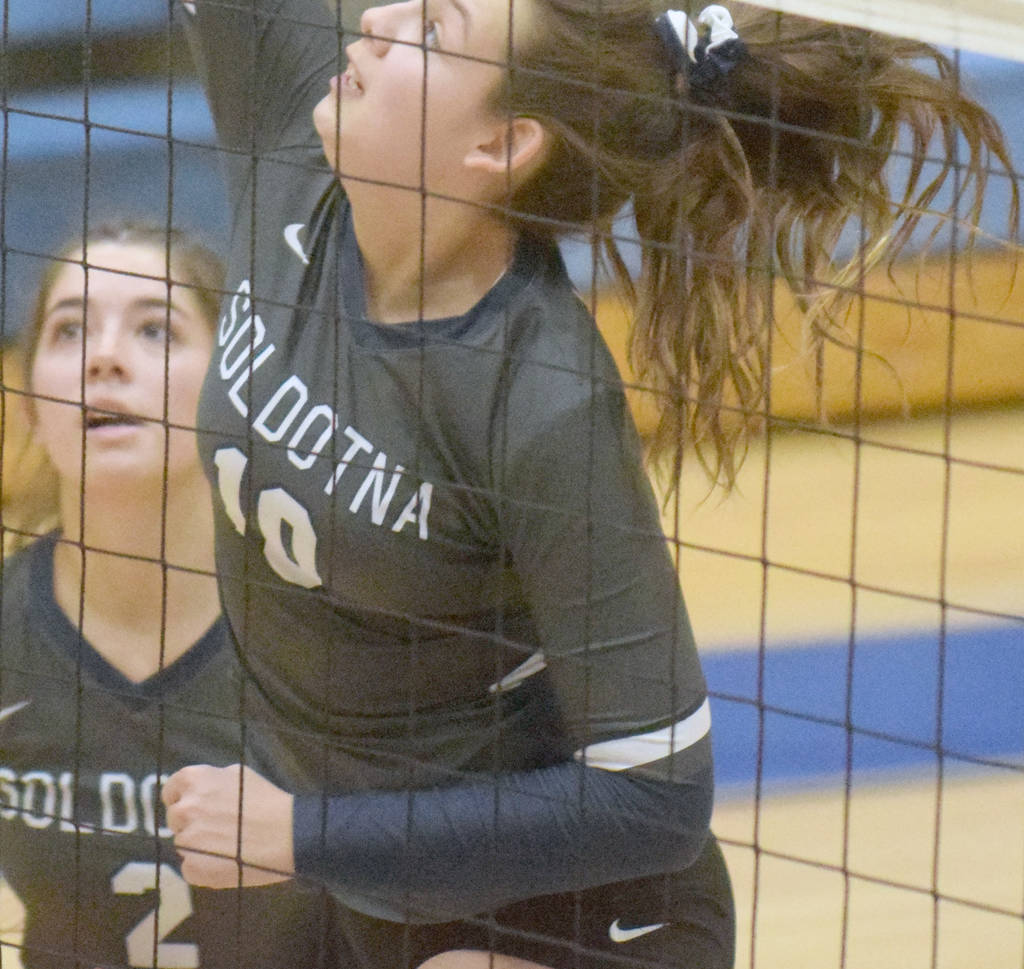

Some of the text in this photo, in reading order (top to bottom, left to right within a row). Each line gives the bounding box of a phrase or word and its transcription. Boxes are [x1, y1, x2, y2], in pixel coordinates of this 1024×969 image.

[218, 279, 433, 540] SOLDOTNA
[214, 447, 322, 589] 10
[111, 862, 199, 968] 2
